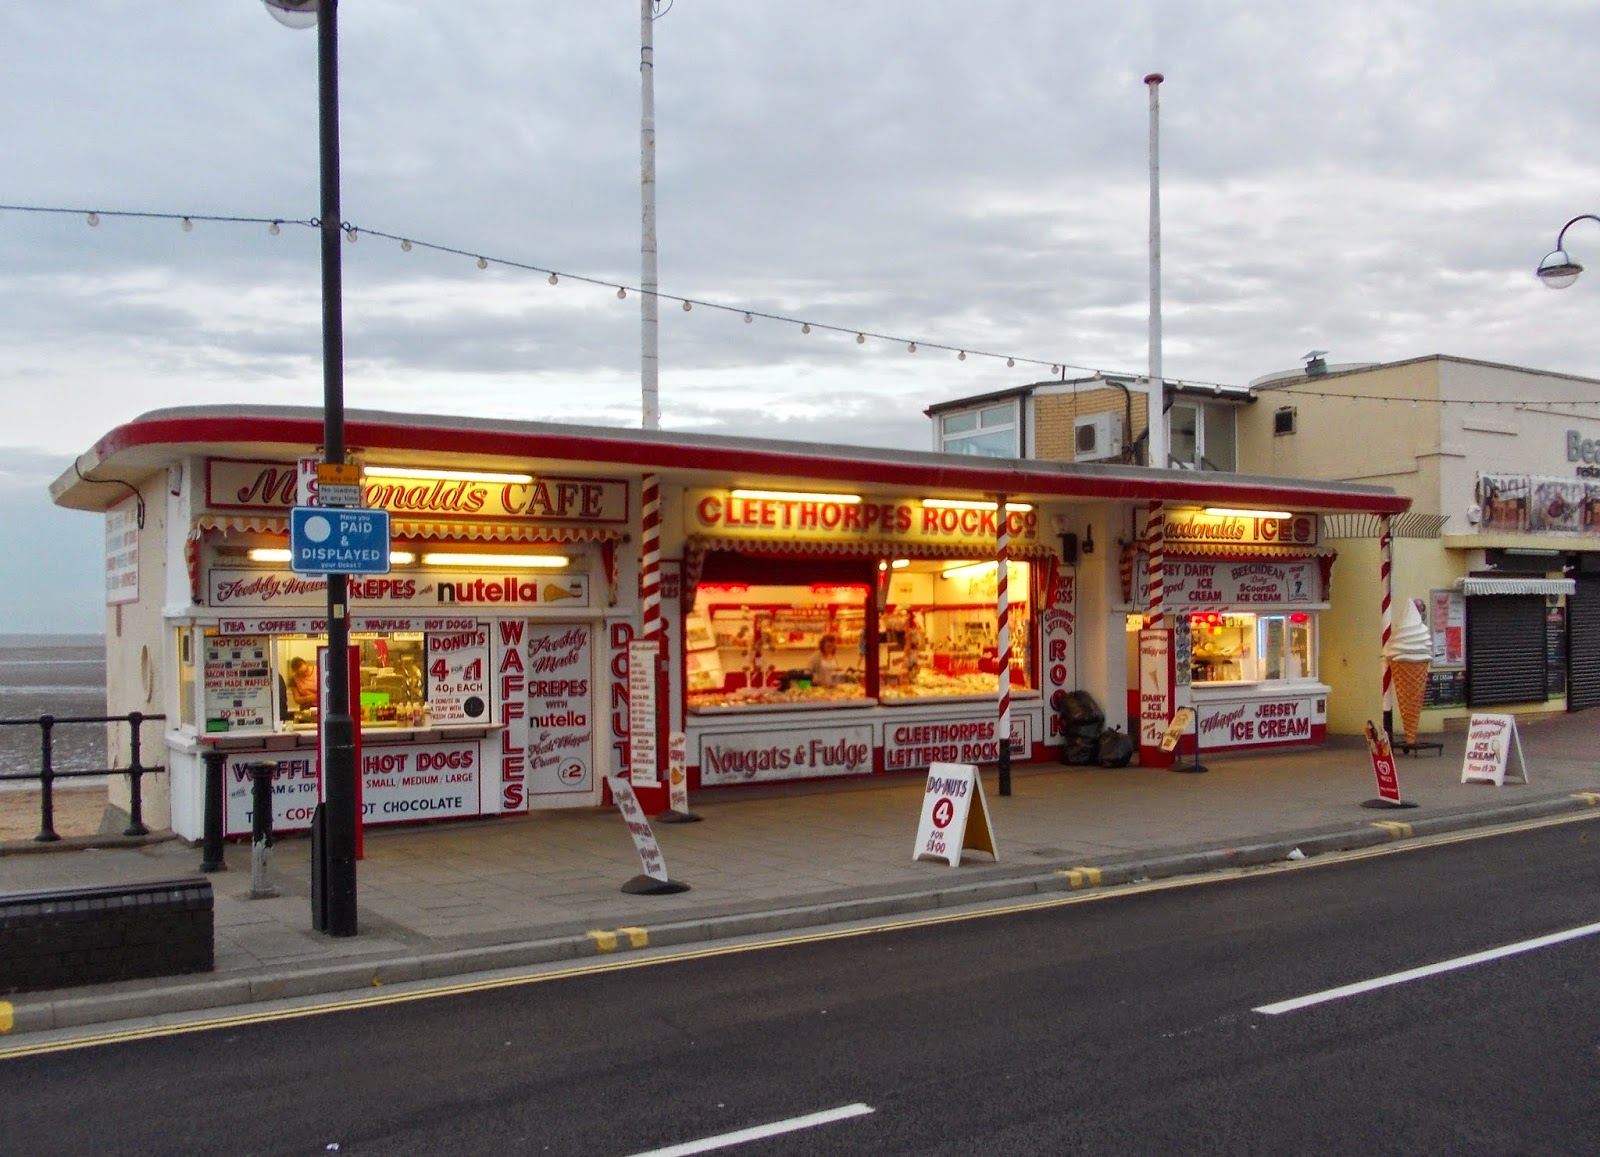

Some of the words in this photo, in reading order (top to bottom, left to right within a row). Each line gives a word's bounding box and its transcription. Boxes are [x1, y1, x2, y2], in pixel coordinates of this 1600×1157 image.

[501, 481, 602, 517] CAFE
[698, 496, 912, 532] CLEETHORPES
[921, 506, 997, 535] ROCK
[341, 522, 372, 533] PAID
[1252, 517, 1311, 542] ICES
[340, 535, 349, 546] &
[302, 548, 381, 560] DISPLAYED
[1184, 564, 1217, 576] DAIRY
[437, 577, 537, 602] nutella
[1197, 578, 1212, 588] ICE
[1188, 590, 1221, 601] CREAM
[1237, 594, 1250, 602] ICE
[1253, 593, 1282, 602] CREAM
[224, 623, 245, 632] TEA
[258, 621, 296, 632] COFFEE
[365, 620, 411, 630] WAFFLES
[424, 619, 443, 629] HOT
[445, 619, 473, 629] DOGS
[234, 639, 258, 647] DOGS
[431, 632, 486, 652] DONUTS
[430, 658, 449, 682] 4
[463, 658, 482, 681] £1
[435, 684, 454, 695] 40p
[457, 683, 483, 692] EACH
[528, 680, 587, 697] CREPES
[500, 621, 525, 809] WAFFLES
[1255, 703, 1299, 717] JERSEY
[530, 711, 586, 728] nutella
[896, 722, 996, 745] CLEETHORPES
[1231, 721, 1254, 741] ICE
[1258, 717, 1310, 739] CREAM
[889, 746, 957, 769] LETTERED
[963, 742, 1000, 765] ROCK
[1474, 743, 1488, 751] ICE
[364, 755, 408, 774] HOT
[416, 751, 473, 771] DOGS
[704, 744, 791, 779] Nougats
[793, 746, 806, 765] &
[808, 738, 869, 773] Fudge
[1467, 752, 1497, 761] CREAM
[562, 764, 582, 778] £2
[383, 797, 463, 815] CHOCOLATE
[936, 801, 951, 826] 4
